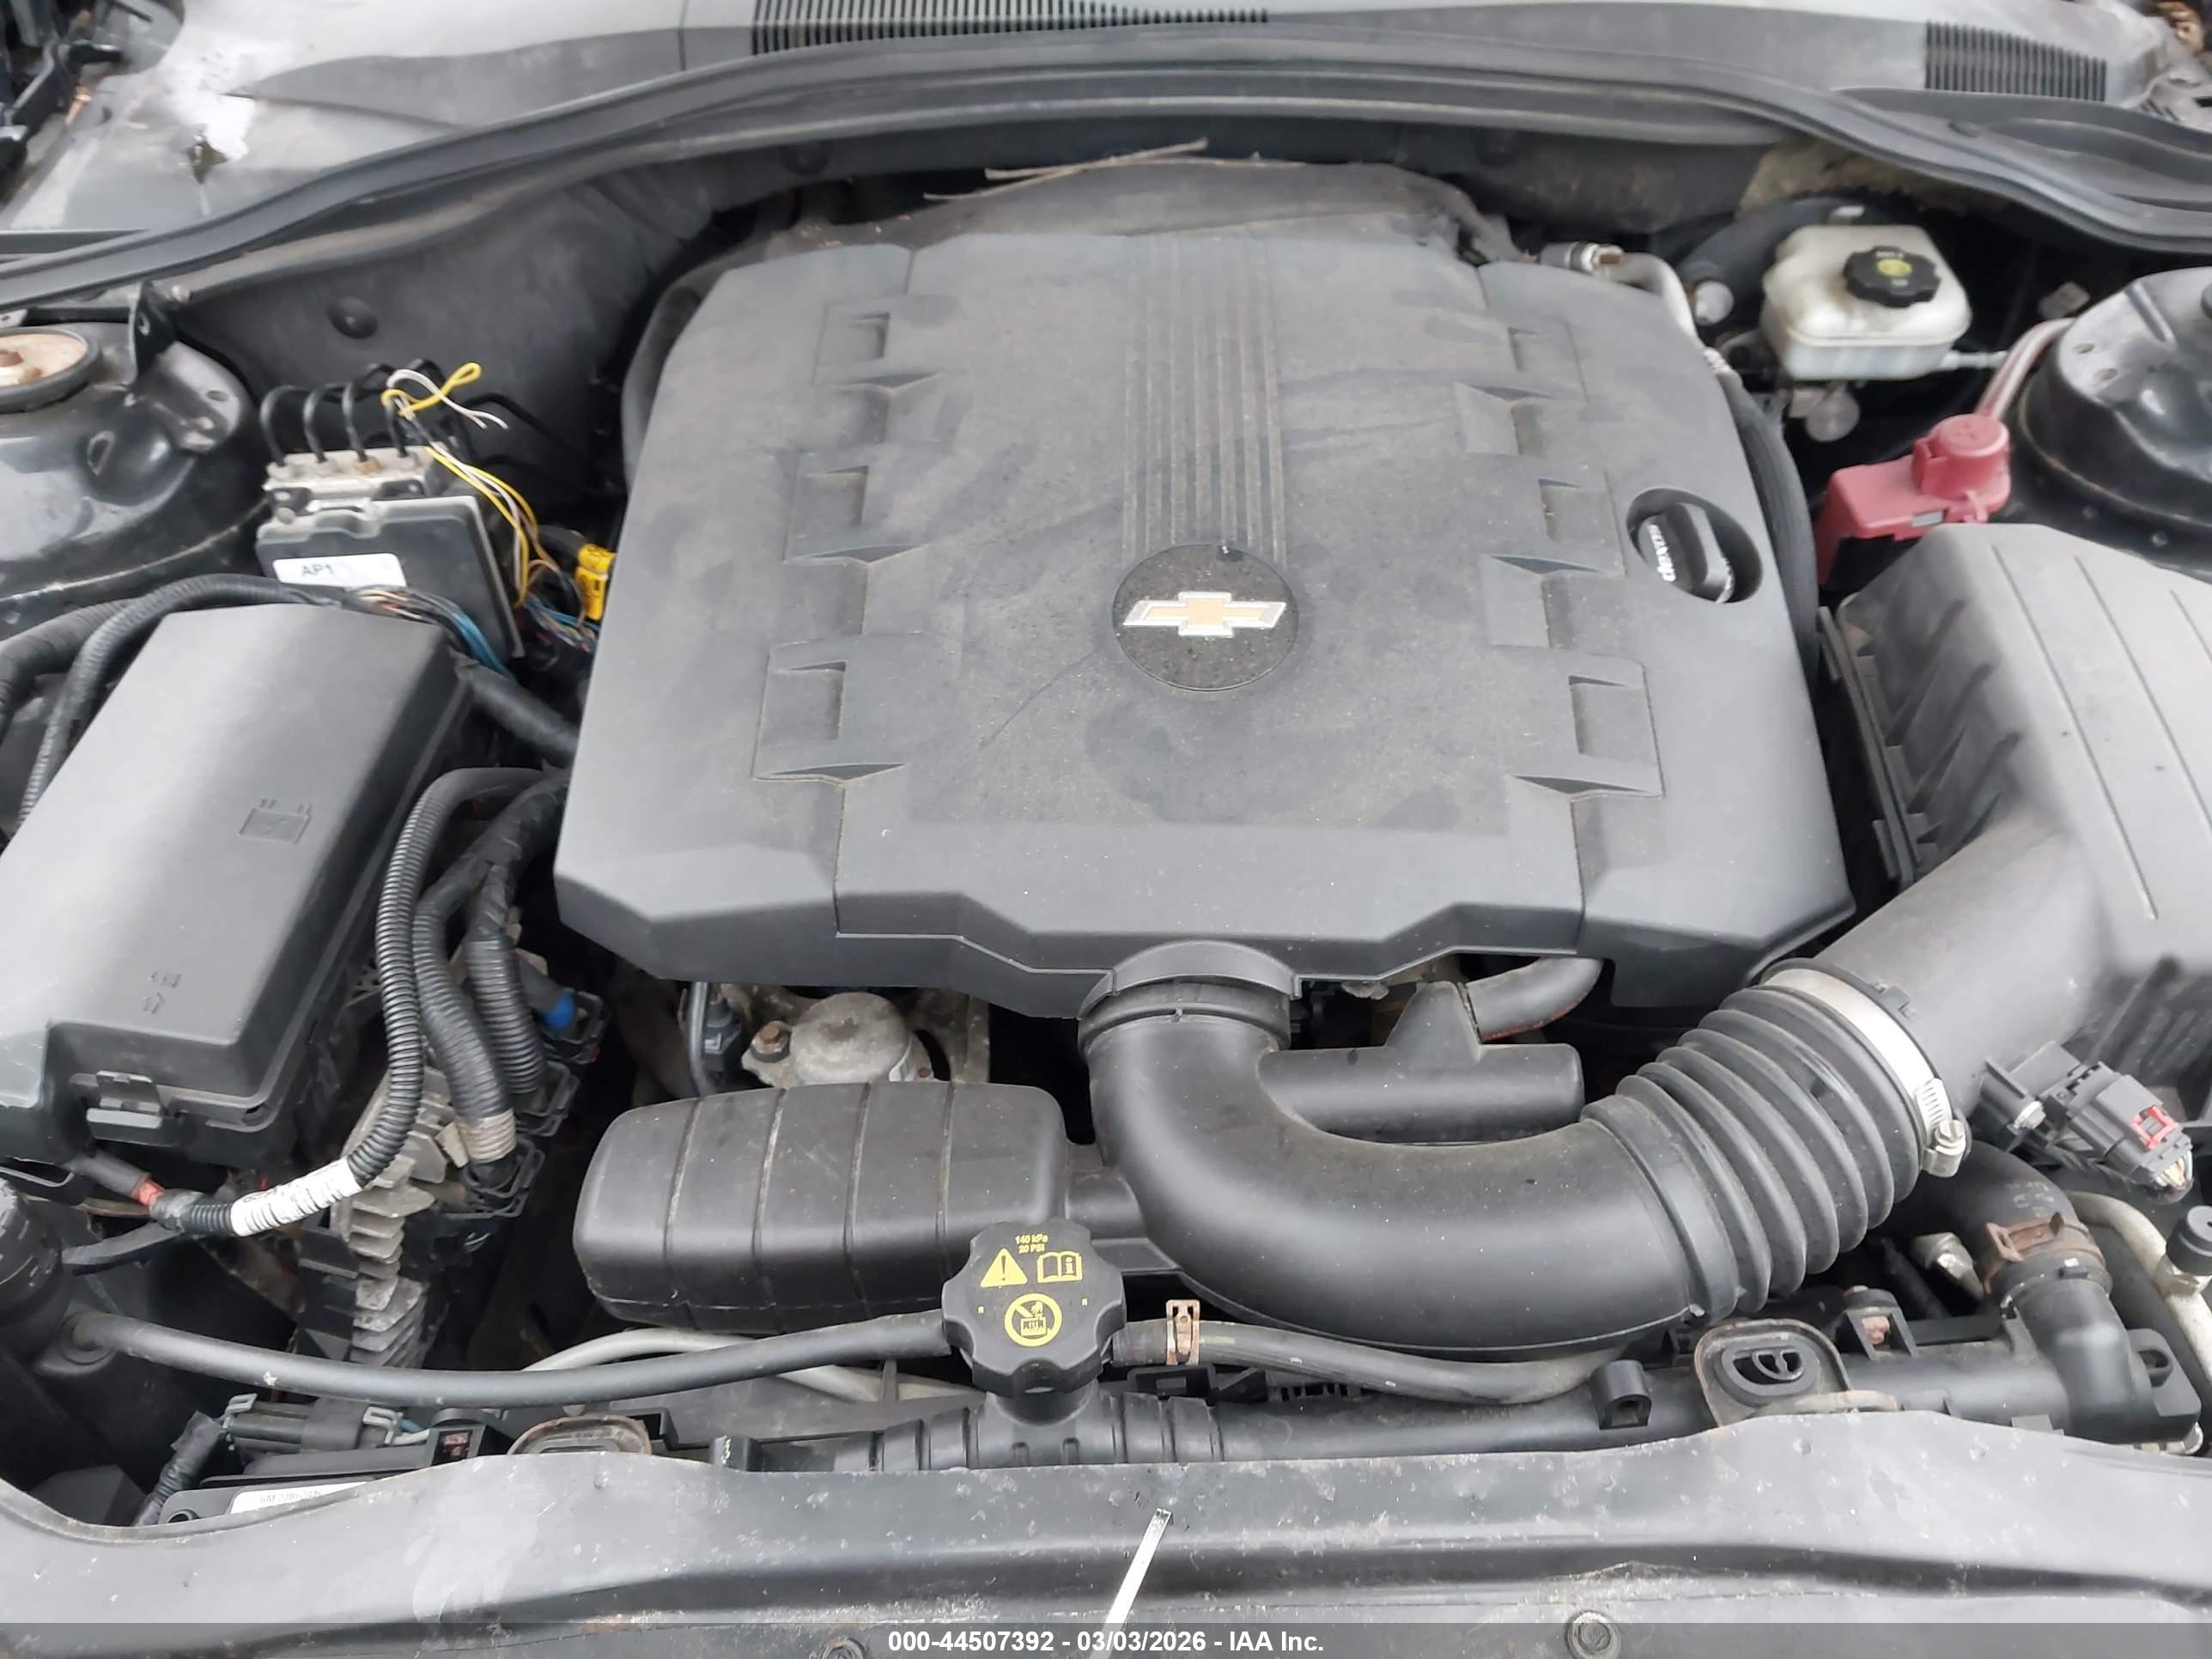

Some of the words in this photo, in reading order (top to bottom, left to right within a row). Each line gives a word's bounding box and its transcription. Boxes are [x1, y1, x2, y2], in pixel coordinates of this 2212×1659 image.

[301, 563, 334, 577] AP1
[1015, 1234, 1031, 1244] 140
[1031, 1233, 1048, 1243] kPa
[1018, 1244, 1030, 1254] 20
[1030, 1243, 1045, 1253] PSI
